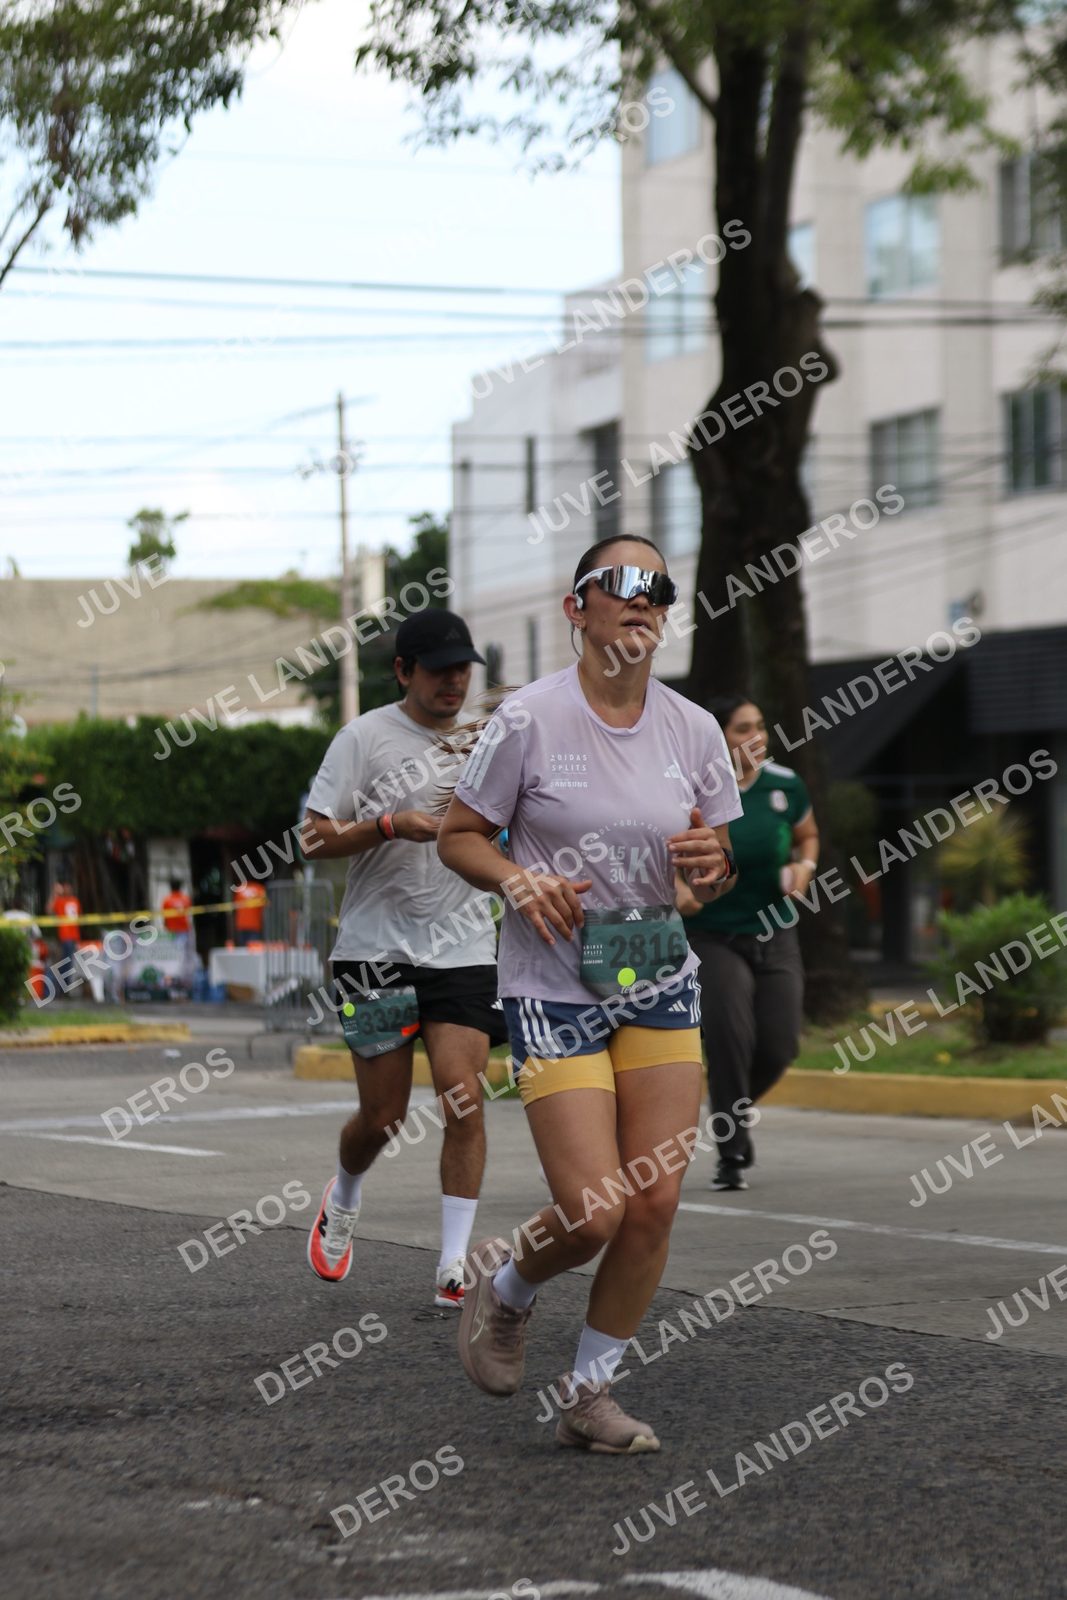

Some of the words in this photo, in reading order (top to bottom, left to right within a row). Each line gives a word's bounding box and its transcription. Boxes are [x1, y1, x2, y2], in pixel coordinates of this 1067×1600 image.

[551, 764, 587, 772] SPLITS
[608, 845, 626, 860] 15
[627, 847, 652, 884] K
[610, 867, 626, 884] 30
[608, 931, 685, 969] 2816
